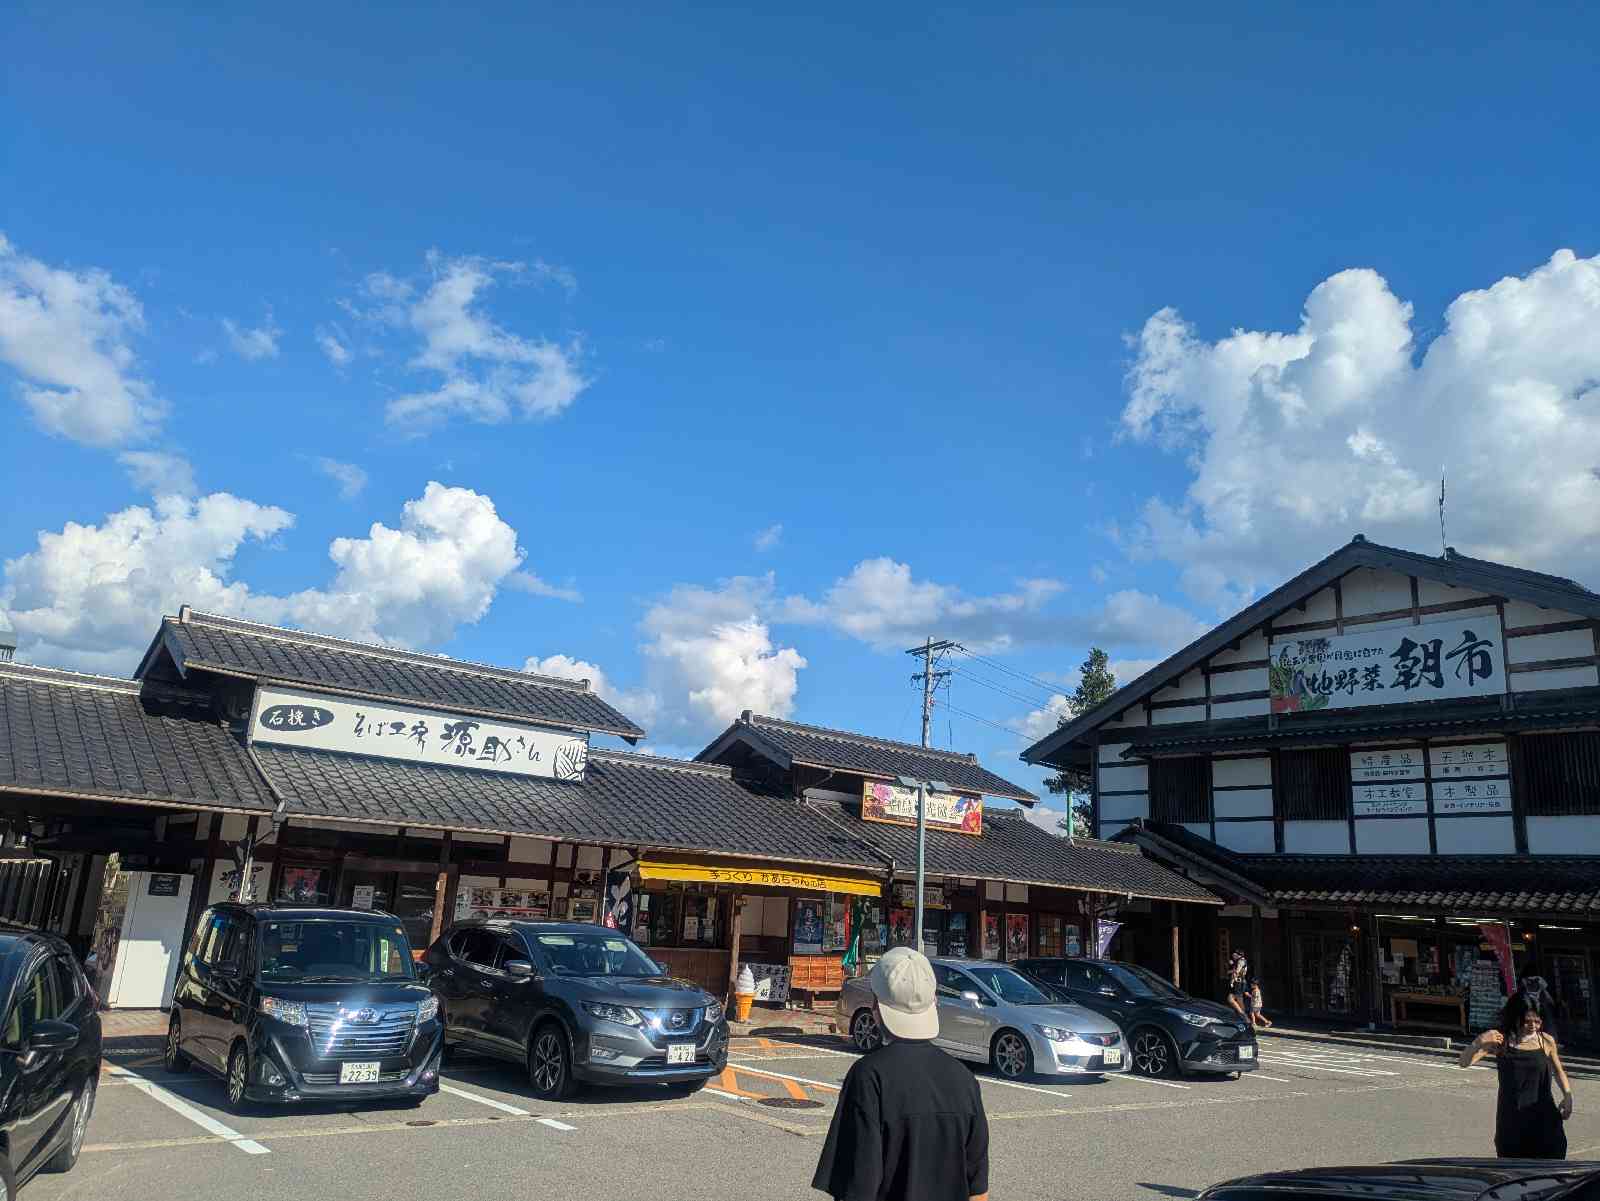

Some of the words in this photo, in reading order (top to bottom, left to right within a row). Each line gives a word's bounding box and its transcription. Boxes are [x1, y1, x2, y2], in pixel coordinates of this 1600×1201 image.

[1307, 664, 1384, 696] 地野菜
[1390, 630, 1494, 691] 朝市
[269, 708, 321, 726] 石挽き
[353, 713, 429, 753] そば工房
[440, 721, 542, 761] 源助さん
[1444, 784, 1498, 797] 木製品
[348, 1070, 378, 1082] 22-39
